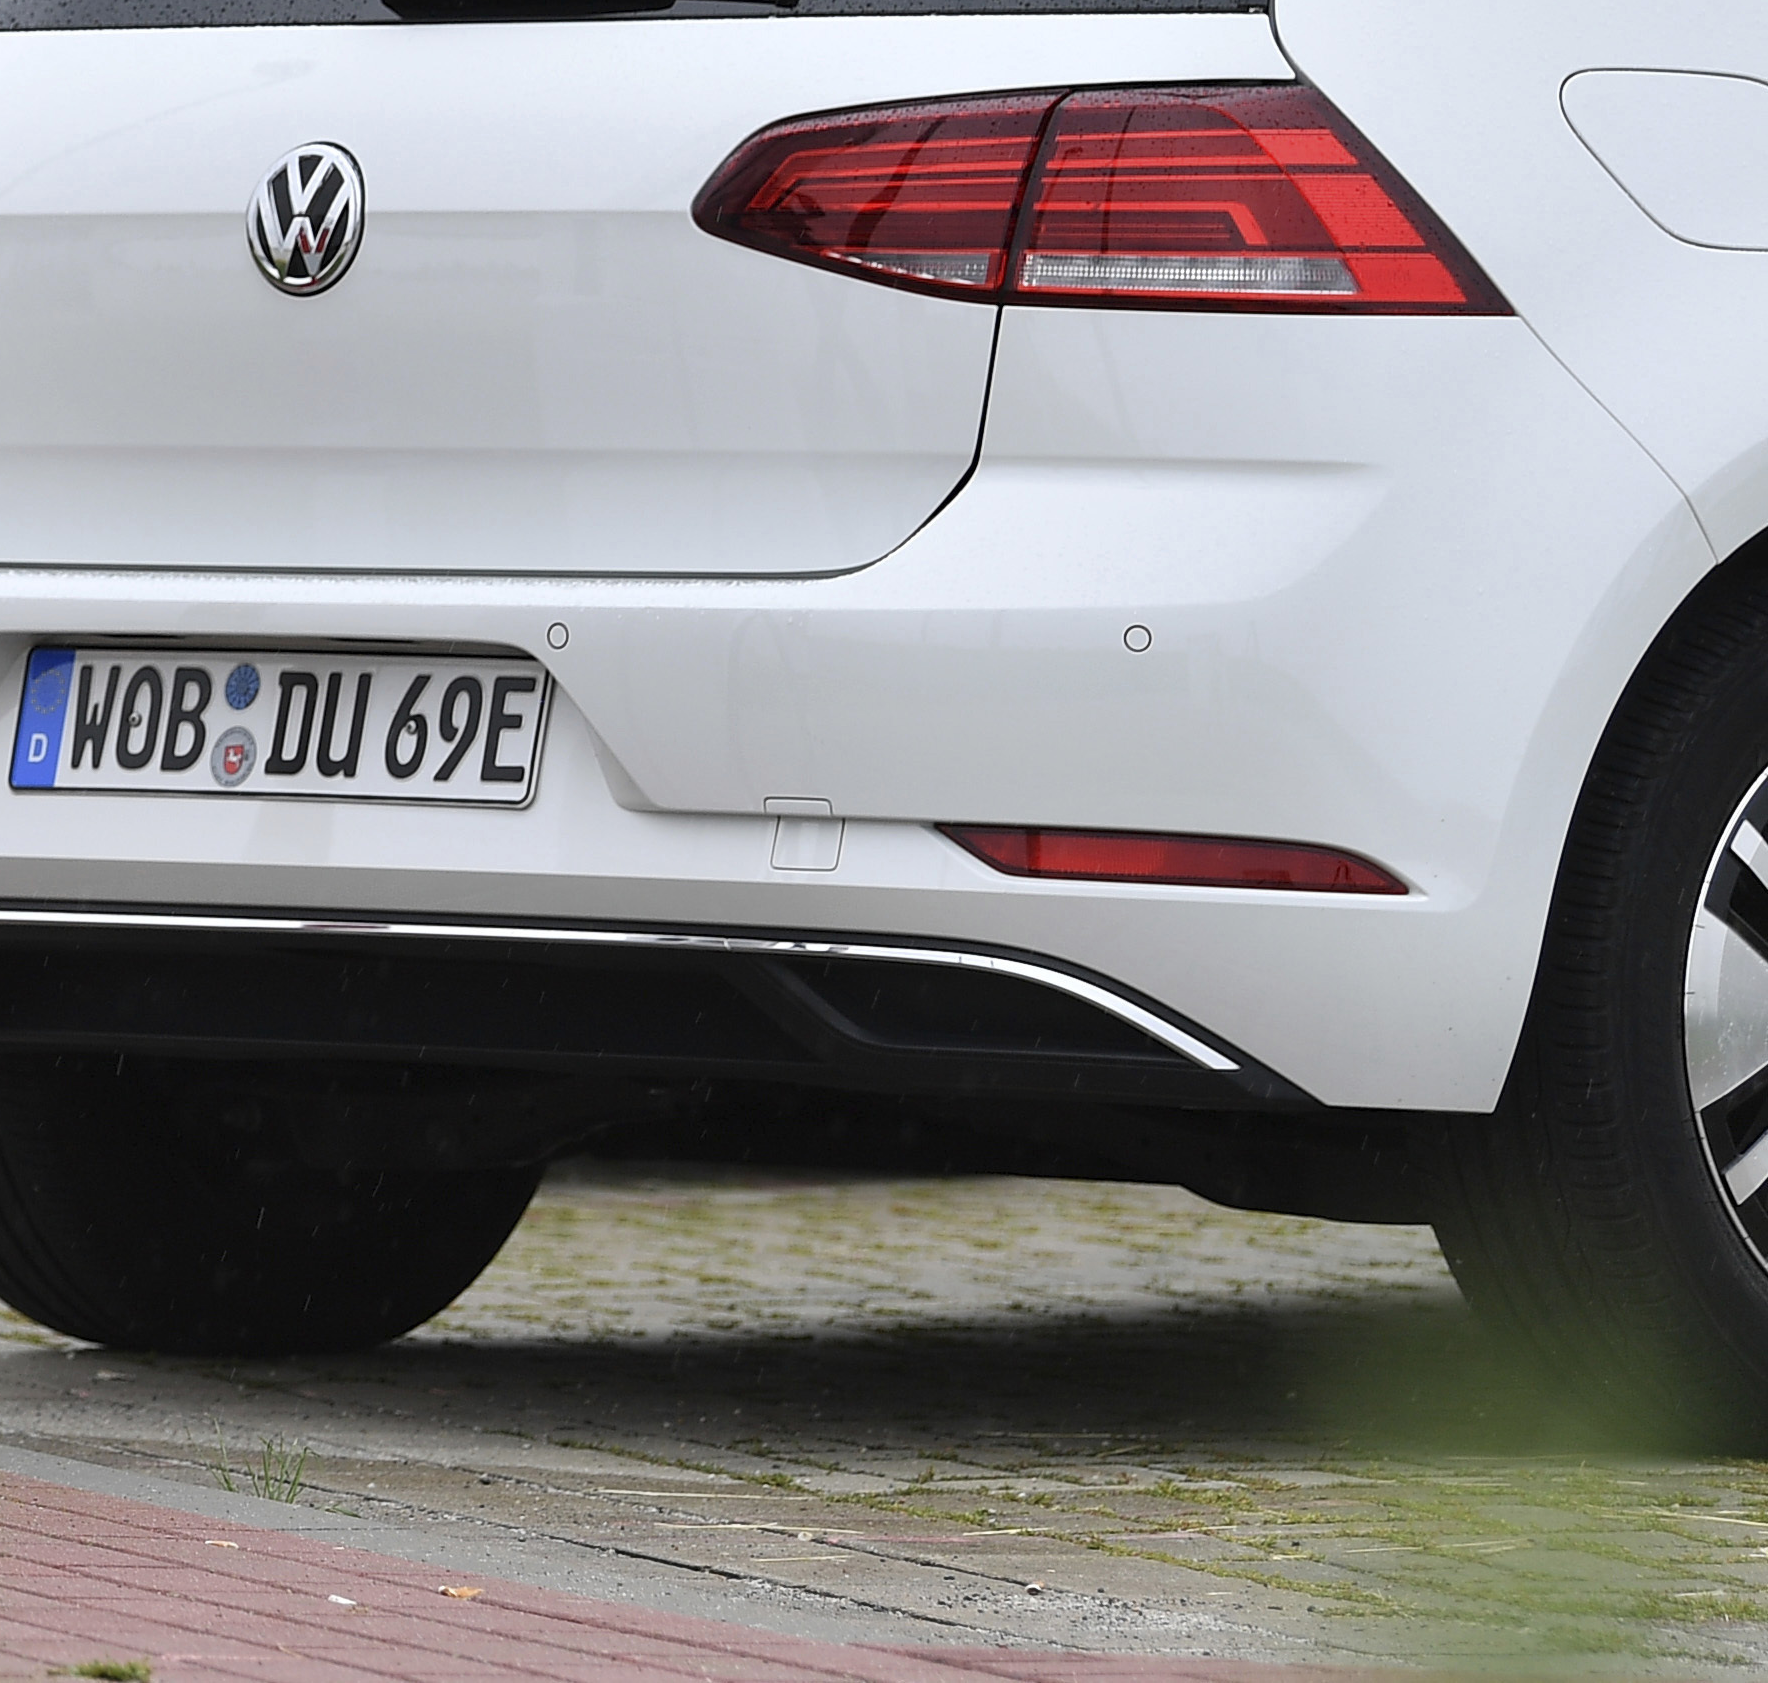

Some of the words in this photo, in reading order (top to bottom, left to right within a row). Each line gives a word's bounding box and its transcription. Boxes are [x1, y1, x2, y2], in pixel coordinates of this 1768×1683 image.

[28, 732, 49, 764] D
[71, 665, 213, 771] WOB
[265, 670, 373, 778] DU
[384, 674, 538, 783] 69E
